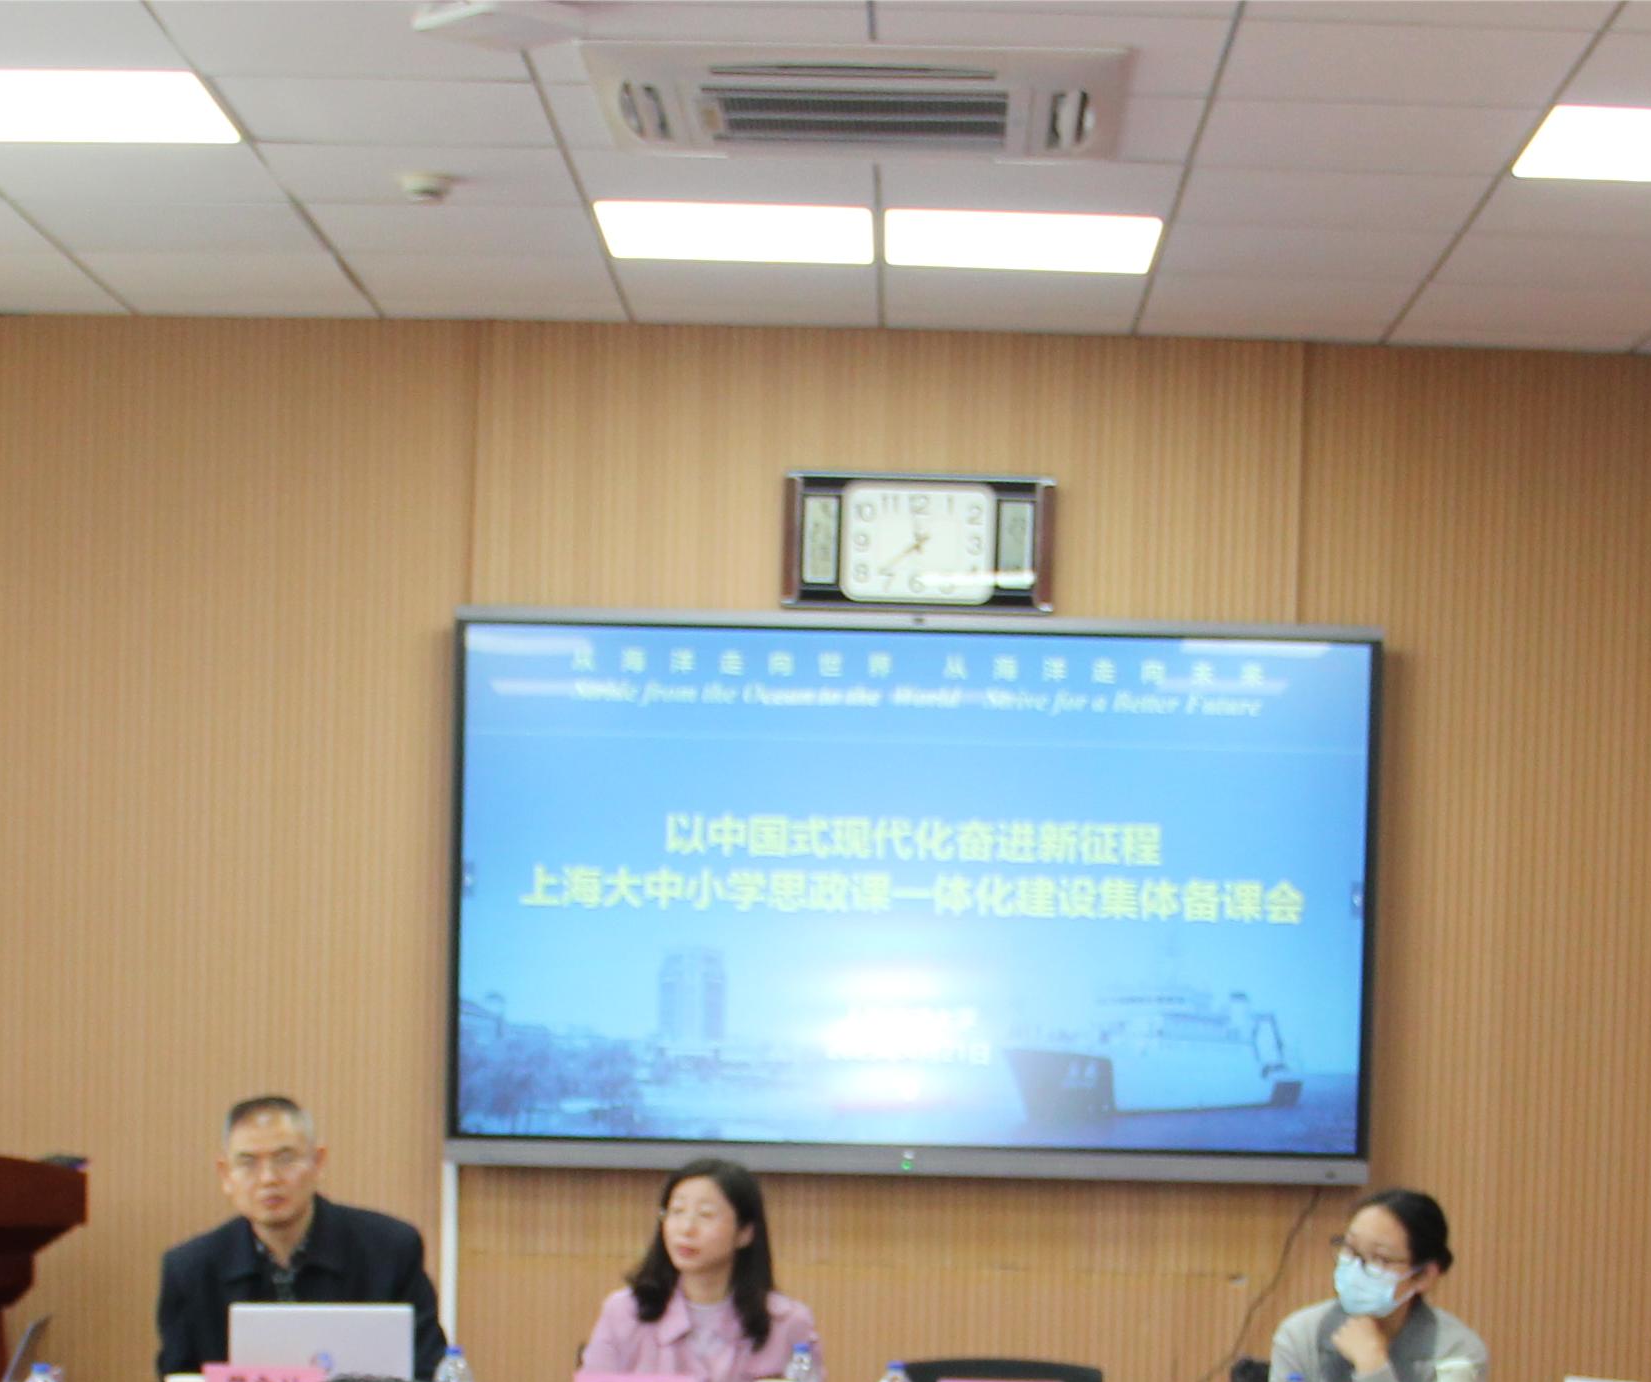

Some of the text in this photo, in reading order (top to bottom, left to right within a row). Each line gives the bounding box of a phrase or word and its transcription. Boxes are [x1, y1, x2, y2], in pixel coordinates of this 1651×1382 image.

[908, 494, 930, 516] 12
[967, 504, 983, 526] 2
[665, 813, 1163, 867] 以中国式现代化奋进新征程
[519, 864, 1306, 925] 上海大中小学思政课一体化建设集体备课会
